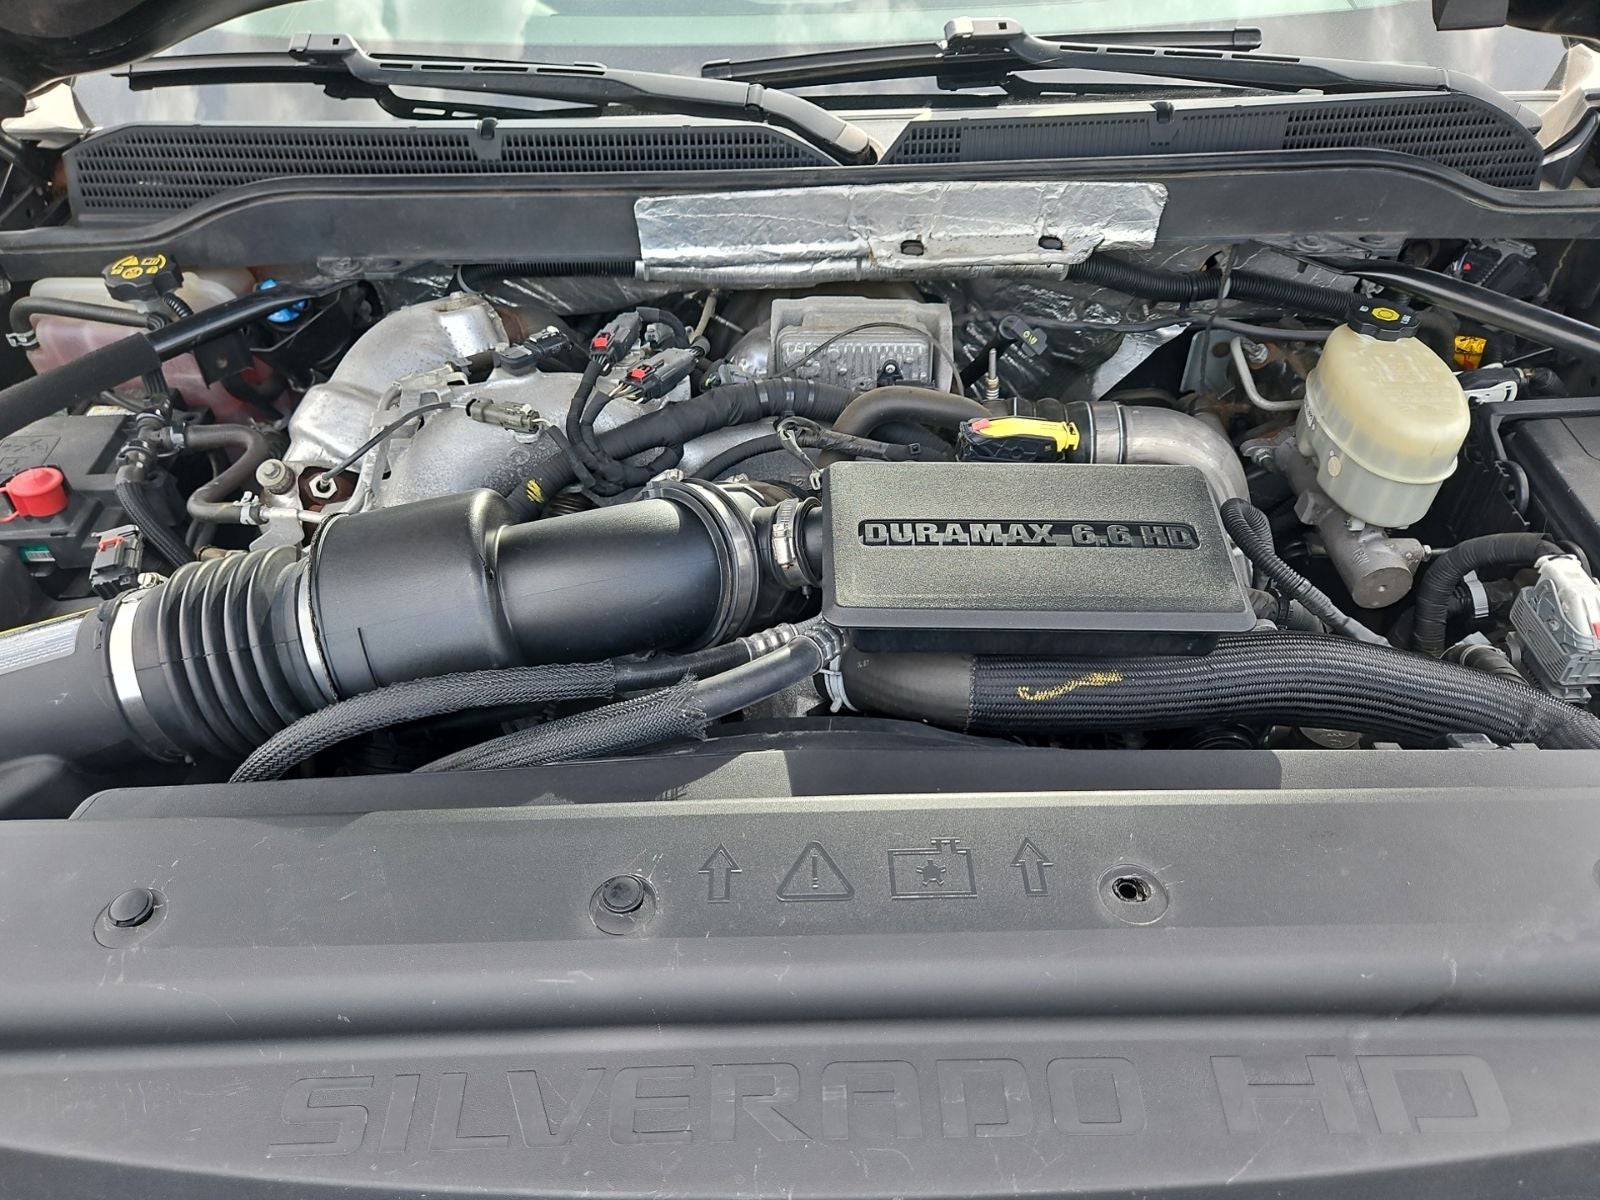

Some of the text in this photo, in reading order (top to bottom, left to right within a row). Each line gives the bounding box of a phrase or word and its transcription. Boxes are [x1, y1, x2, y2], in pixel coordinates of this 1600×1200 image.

[864, 522, 1195, 547] DURAMAX 6.6 HD
[266, 1054, 1512, 1158] SILVERADO HD
